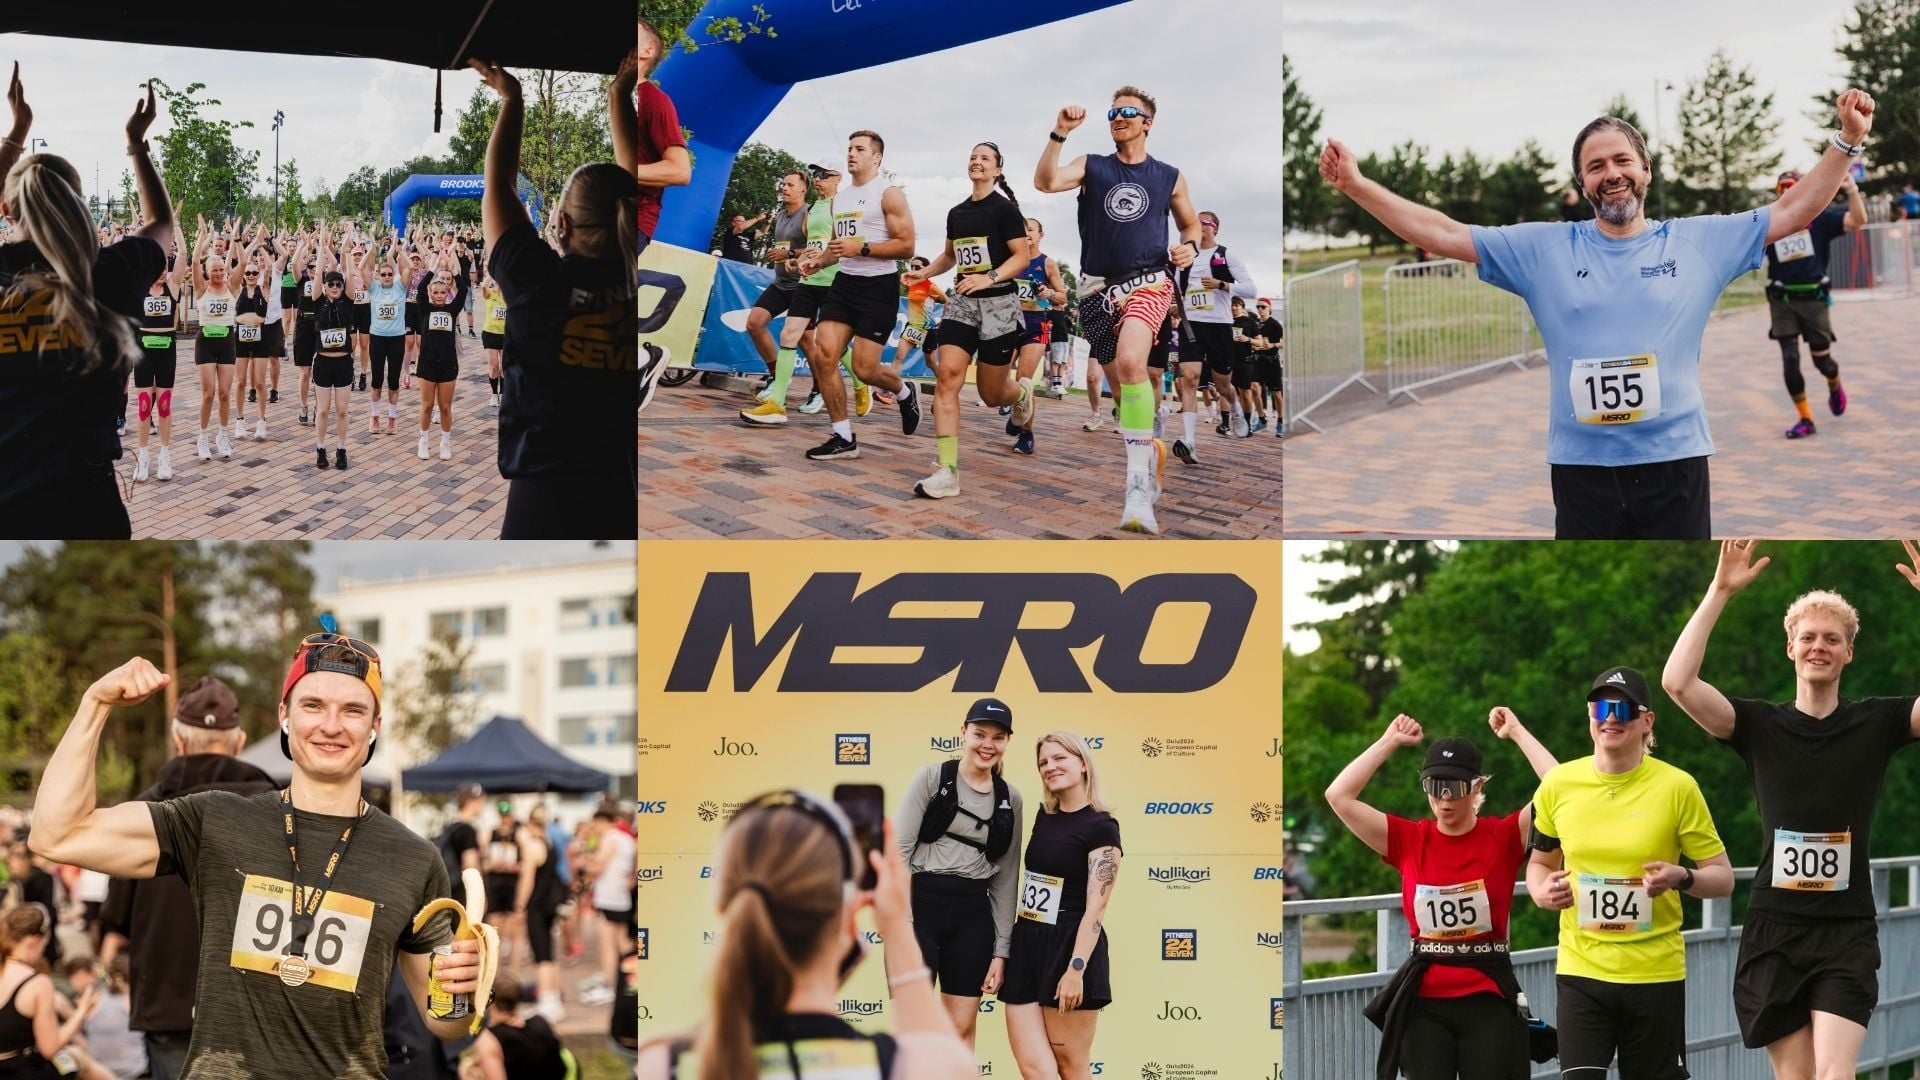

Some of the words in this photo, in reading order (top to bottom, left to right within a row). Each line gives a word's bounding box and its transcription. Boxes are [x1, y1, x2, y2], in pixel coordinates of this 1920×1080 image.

[837, 220, 857, 237] 015
[957, 246, 982, 266] 035
[1019, 286, 1034, 299] 24
[1191, 294, 1207, 306] 011
[147, 301, 168, 313] 365
[209, 303, 228, 313] 299
[378, 307, 395, 316] 390
[433, 316, 449, 326] 319
[0, 322, 86, 355] EVEN
[241, 328, 257, 339] 267
[324, 333, 344, 344] 443
[906, 329, 923, 342] 044
[1585, 373, 1643, 410] 155
[1601, 413, 1631, 422] MSRO
[664, 572, 1257, 693] MSRO
[713, 736, 758, 756] Joo.
[838, 743, 868, 755] 24
[931, 736, 964, 749] Nalli
[1144, 802, 1214, 815] BROOKS
[324, 852, 340, 878] MSRO
[1783, 846, 1839, 878] 308
[1148, 866, 1210, 879] Nallikari
[1797, 881, 1825, 889] MSRO
[306, 888, 323, 915] MSRO
[1589, 889, 1640, 920] 184
[1426, 896, 1477, 929] 185
[1599, 923, 1626, 931] MSRO
[1165, 938, 1194, 951] 24
[1420, 942, 1455, 953] adidas
[1165, 950, 1194, 958] SEVEN
[1157, 1000, 1202, 1021] Joo.
